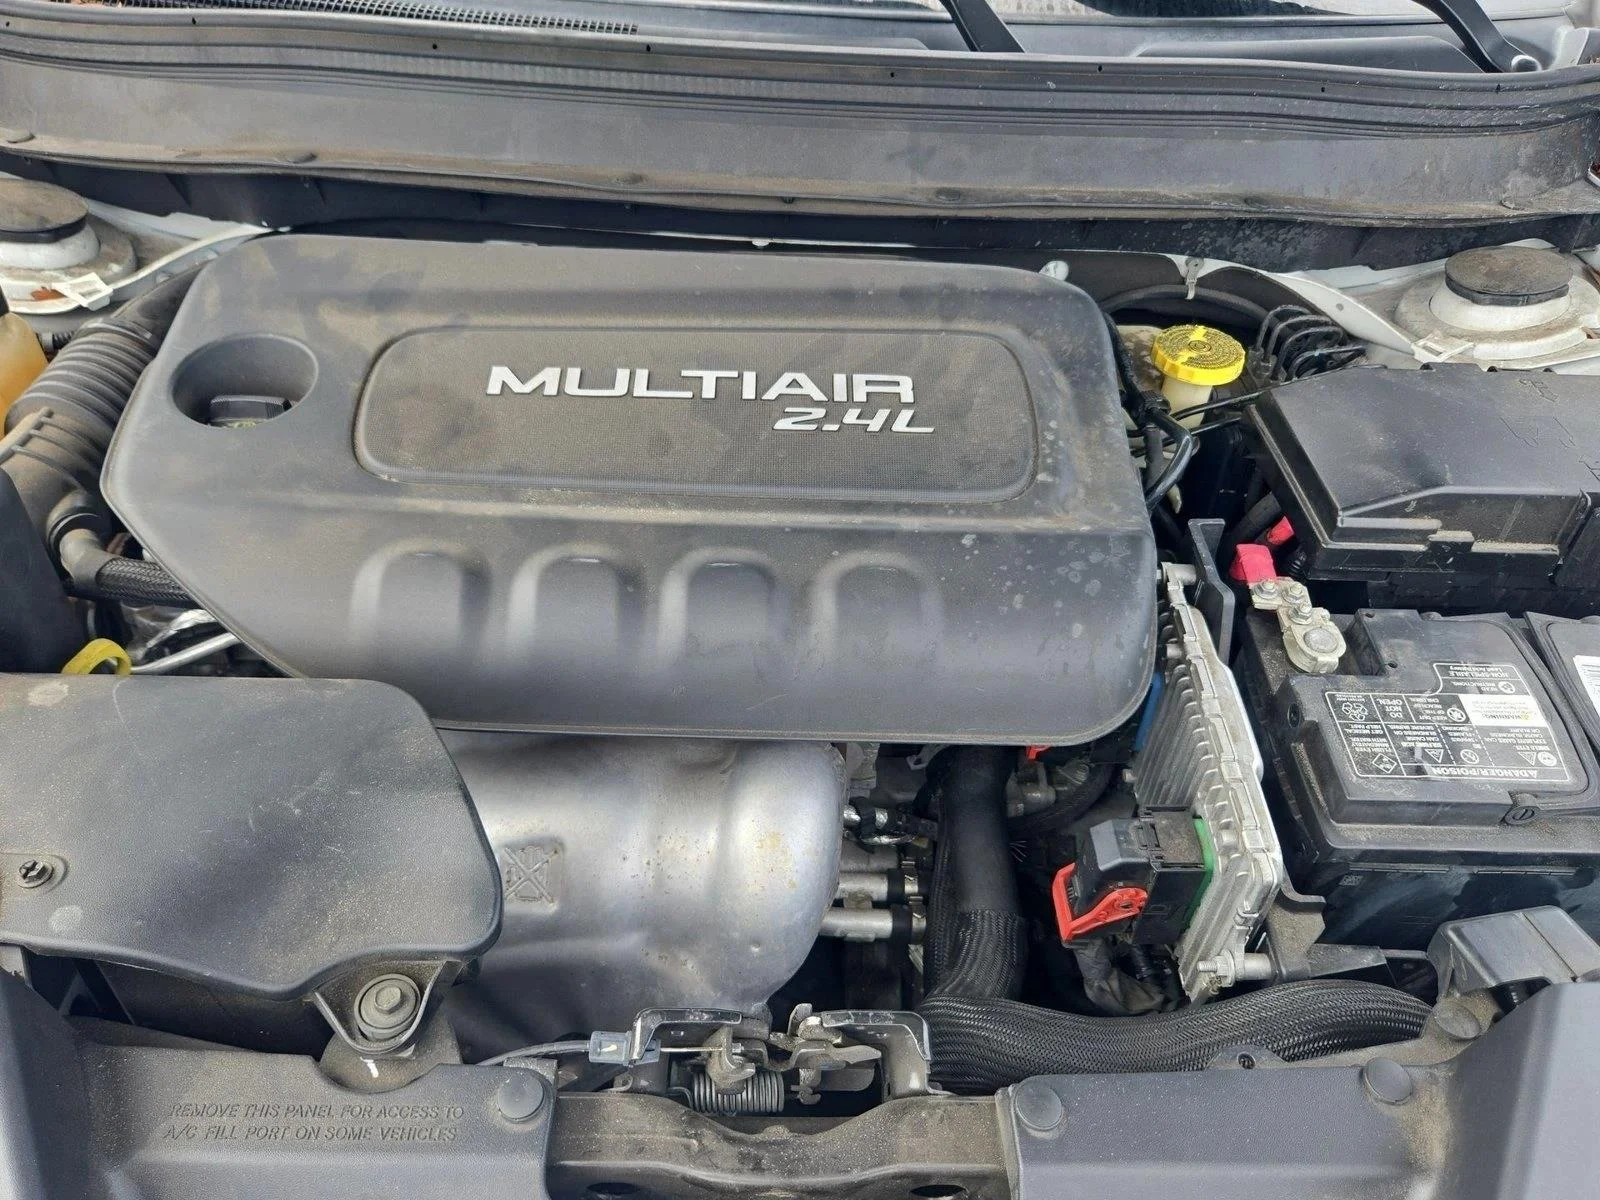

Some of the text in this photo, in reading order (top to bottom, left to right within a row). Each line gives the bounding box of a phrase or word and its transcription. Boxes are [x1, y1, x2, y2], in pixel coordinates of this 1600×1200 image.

[486, 366, 916, 404] MULTIAIR
[772, 406, 936, 434] 2.4L
[1431, 767, 1530, 777] DANGER/POISON
[170, 1103, 464, 1120] REMOVE THIS PANEL FOR ACCESS TO
[163, 1123, 457, 1142] A/C FILL PORT ON SOME VEHICLES
